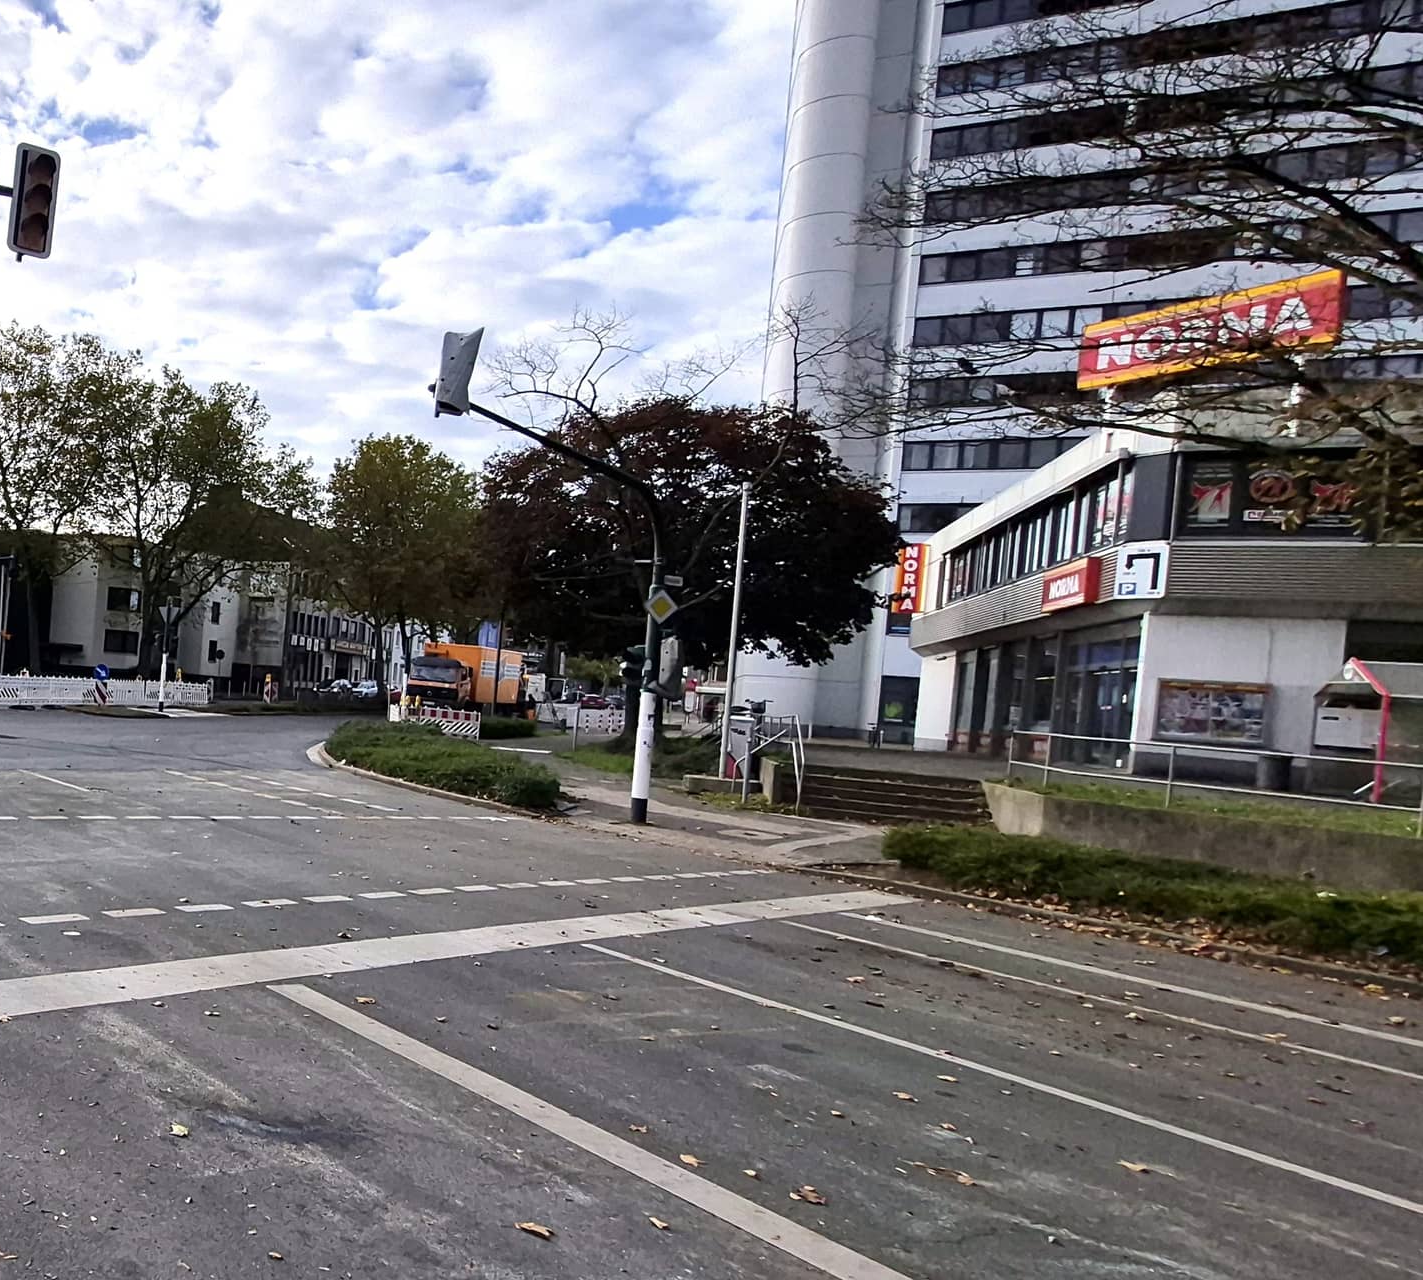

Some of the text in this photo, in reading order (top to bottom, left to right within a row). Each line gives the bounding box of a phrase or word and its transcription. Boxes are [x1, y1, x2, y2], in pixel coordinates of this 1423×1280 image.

[1096, 297, 1314, 370] NORMA
[900, 546, 919, 610] NORMA
[1048, 574, 1079, 600] NORMA
